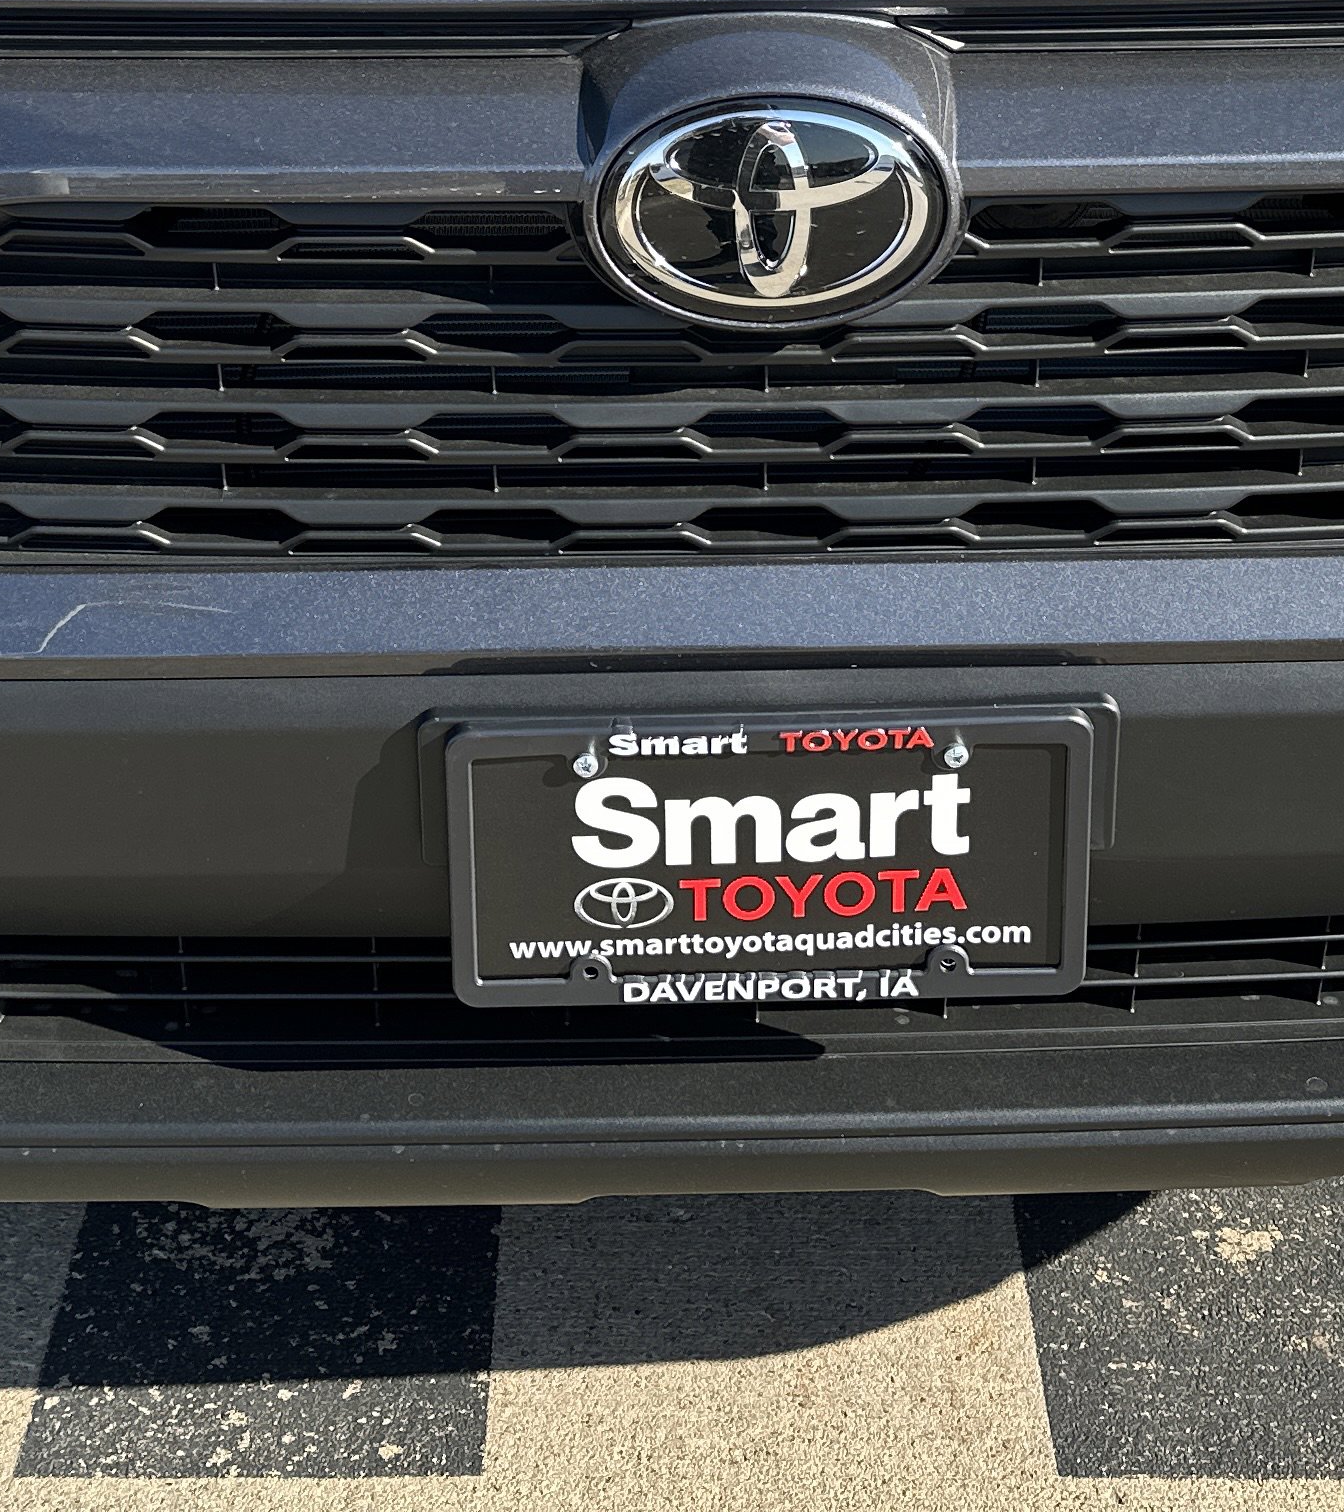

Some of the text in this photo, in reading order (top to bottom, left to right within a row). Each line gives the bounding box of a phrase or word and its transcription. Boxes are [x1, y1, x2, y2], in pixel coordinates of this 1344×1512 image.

[609, 725, 935, 756] Smart TOYOTA
[571, 772, 971, 869] Smart
[679, 867, 968, 922] TOYOTA
[508, 921, 1032, 960] www.smarttoyotaquadcities.com
[622, 969, 920, 1003] DAVENPORT, IA
